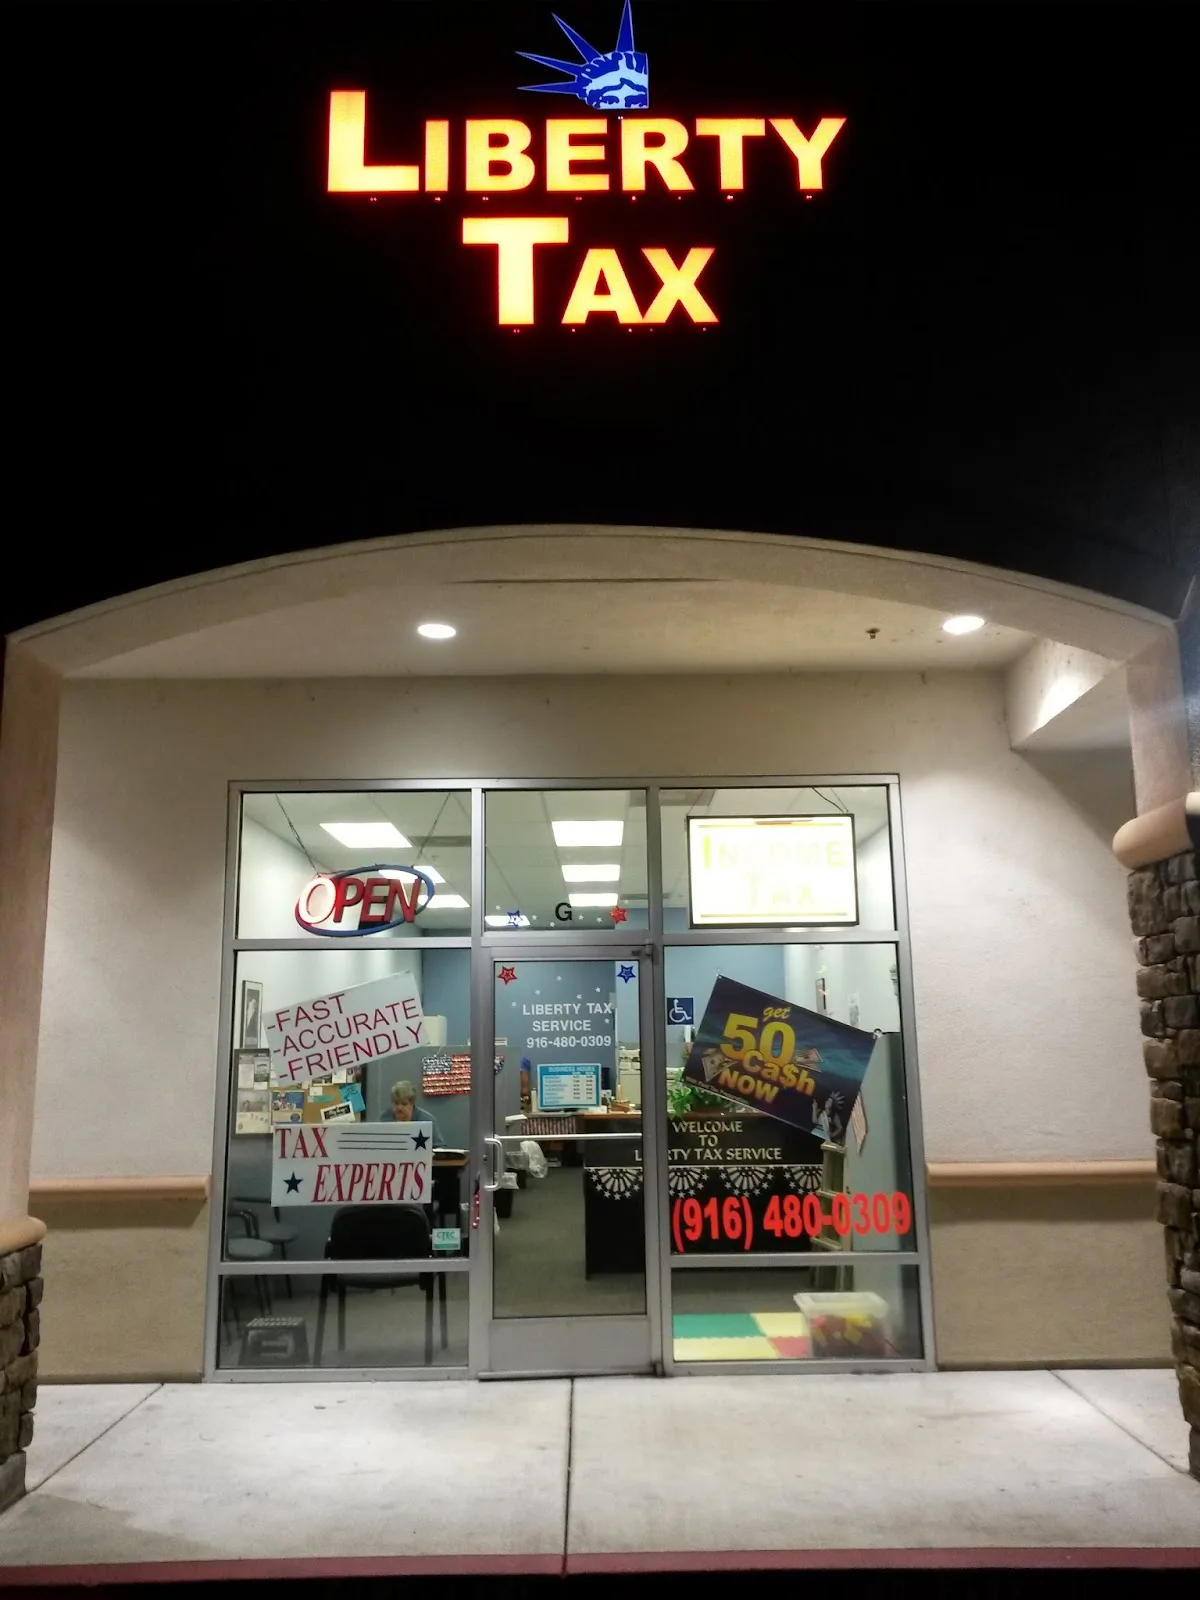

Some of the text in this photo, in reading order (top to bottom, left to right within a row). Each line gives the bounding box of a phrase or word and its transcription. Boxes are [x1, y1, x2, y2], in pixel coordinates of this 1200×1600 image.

[326, 88, 847, 194] LIBERTY
[461, 216, 720, 326] TAX
[299, 876, 423, 925] OPEN
[555, 902, 573, 921] G
[522, 1002, 613, 1016] LIBERTY TAX
[762, 1005, 792, 1022] get
[532, 1019, 592, 1032] SERVICE
[526, 1035, 612, 1048] 916-480-0309
[719, 1012, 796, 1066] 50
[718, 1068, 780, 1104] NOW
[672, 1120, 743, 1133] WELCOME
[275, 1127, 329, 1160] TAX
[699, 1134, 718, 1147] TO
[693, 1147, 723, 1161] TAX
[726, 1147, 782, 1161] SERVICE
[311, 1161, 426, 1203] EXPERTS
[672, 1191, 912, 1254] (916) 480-0309
